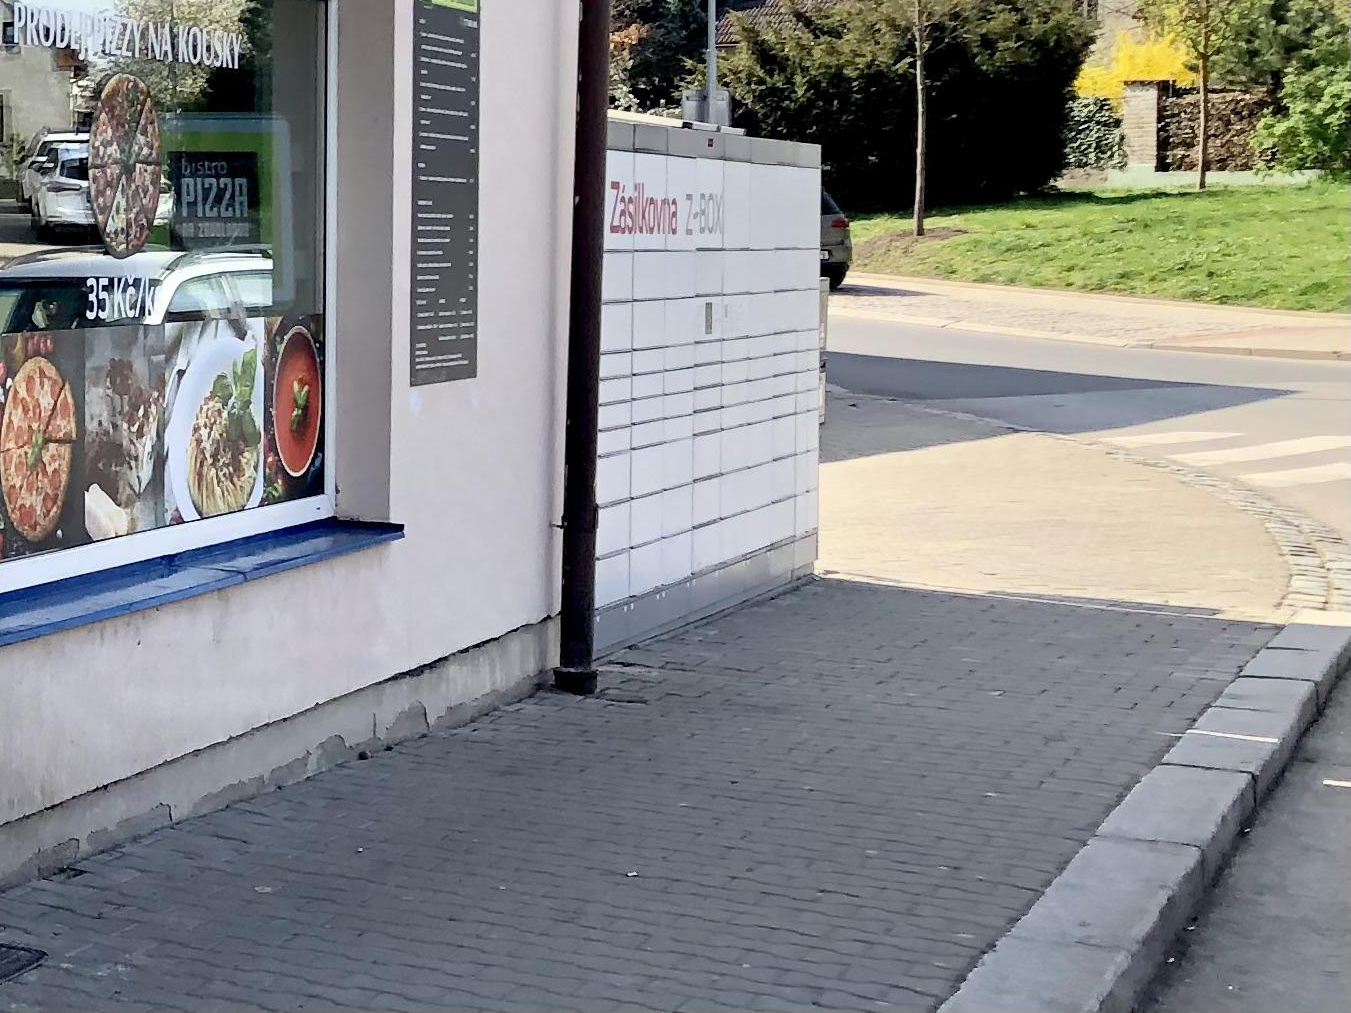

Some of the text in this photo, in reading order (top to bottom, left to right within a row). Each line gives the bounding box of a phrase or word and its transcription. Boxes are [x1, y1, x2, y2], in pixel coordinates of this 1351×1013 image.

[147, 21, 174, 62] NA
[178, 26, 242, 69] KOUSKY
[181, 176, 249, 218] PIZZA
[609, 181, 678, 235] Zásilkovna
[85, 274, 156, 320] 35 Kč/k
